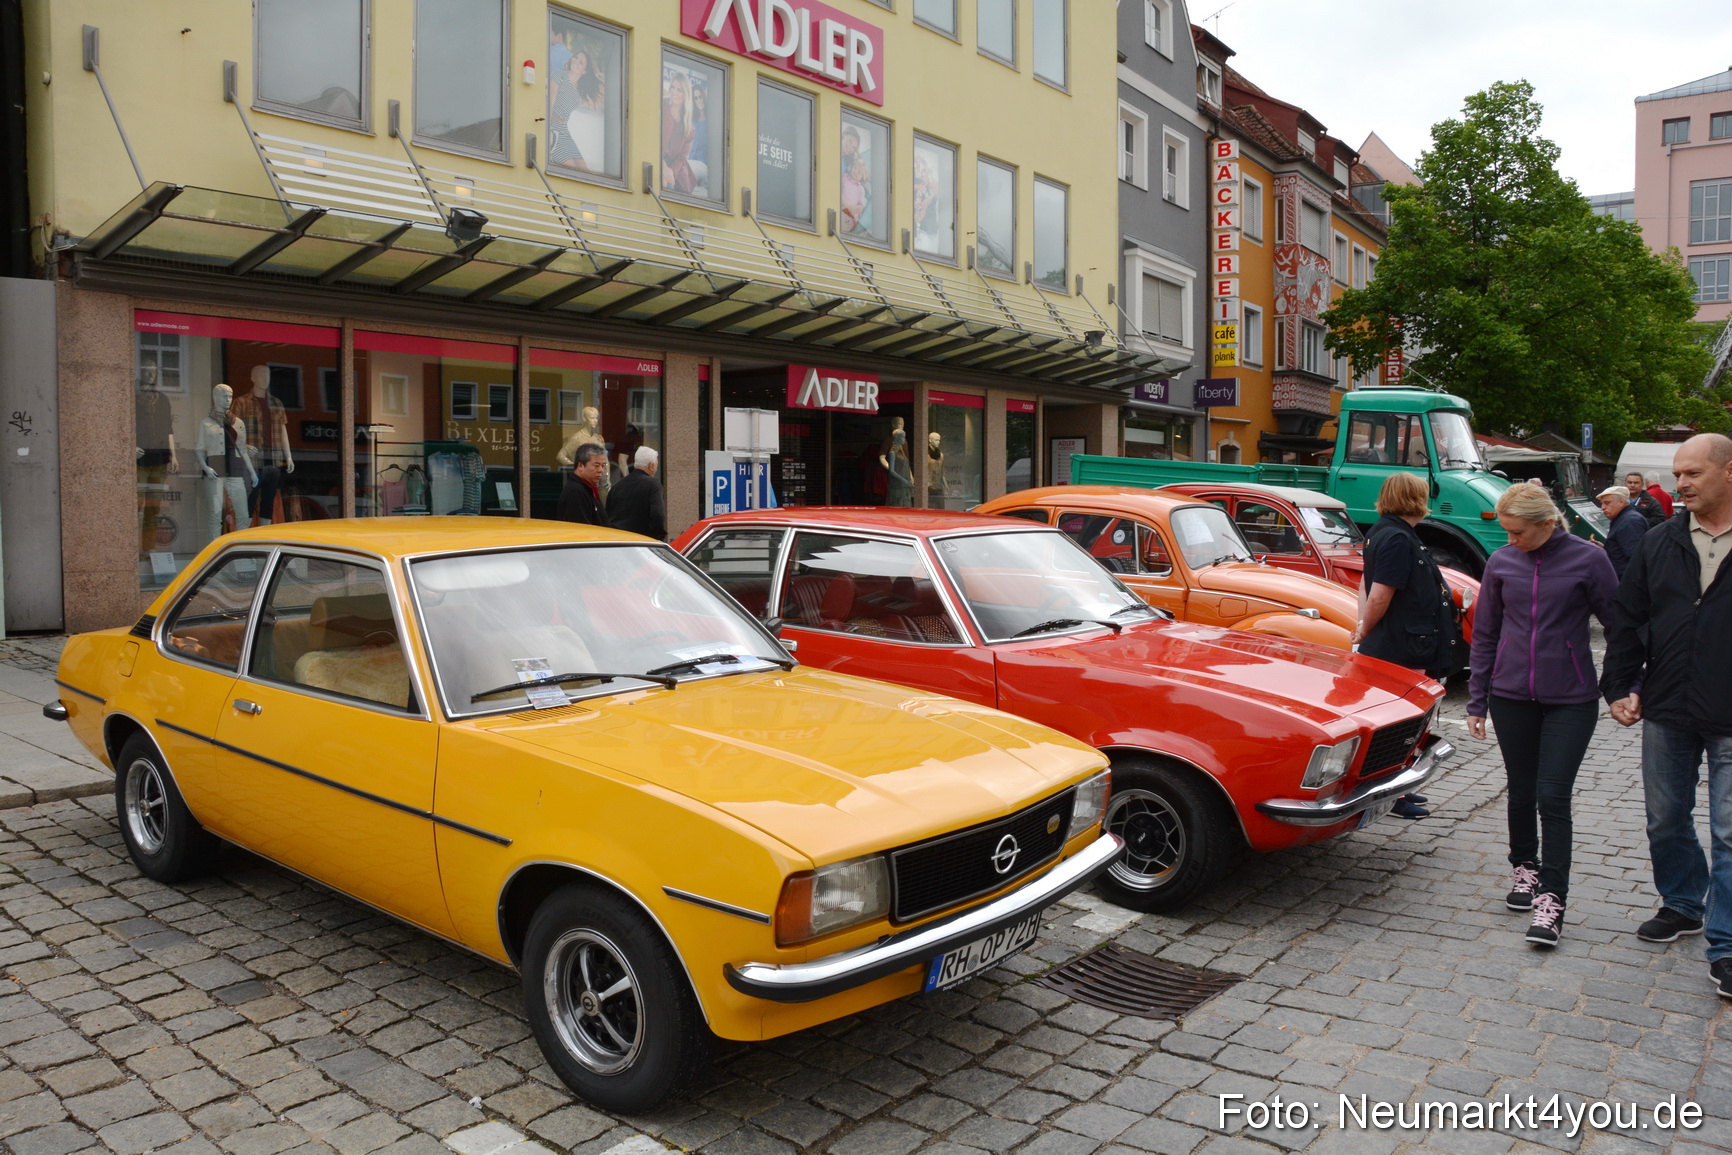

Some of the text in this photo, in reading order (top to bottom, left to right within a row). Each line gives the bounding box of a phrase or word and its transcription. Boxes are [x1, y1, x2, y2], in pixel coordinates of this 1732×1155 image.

[704, 0, 876, 92] ADLER
[770, 146, 792, 163] SEITE
[1217, 142, 1232, 319] BÄCKEREI
[137, 322, 190, 330] www.adlermode.com
[1215, 327, 1235, 340] café
[1215, 351, 1235, 364] plank
[637, 362, 659, 373] ADLER
[796, 367, 880, 411] ADLER
[1198, 385, 1234, 400] liberty
[446, 420, 541, 445] BEXLES
[739, 464, 764, 476] HIR
[716, 476, 728, 498] P
[939, 946, 972, 983] RH
